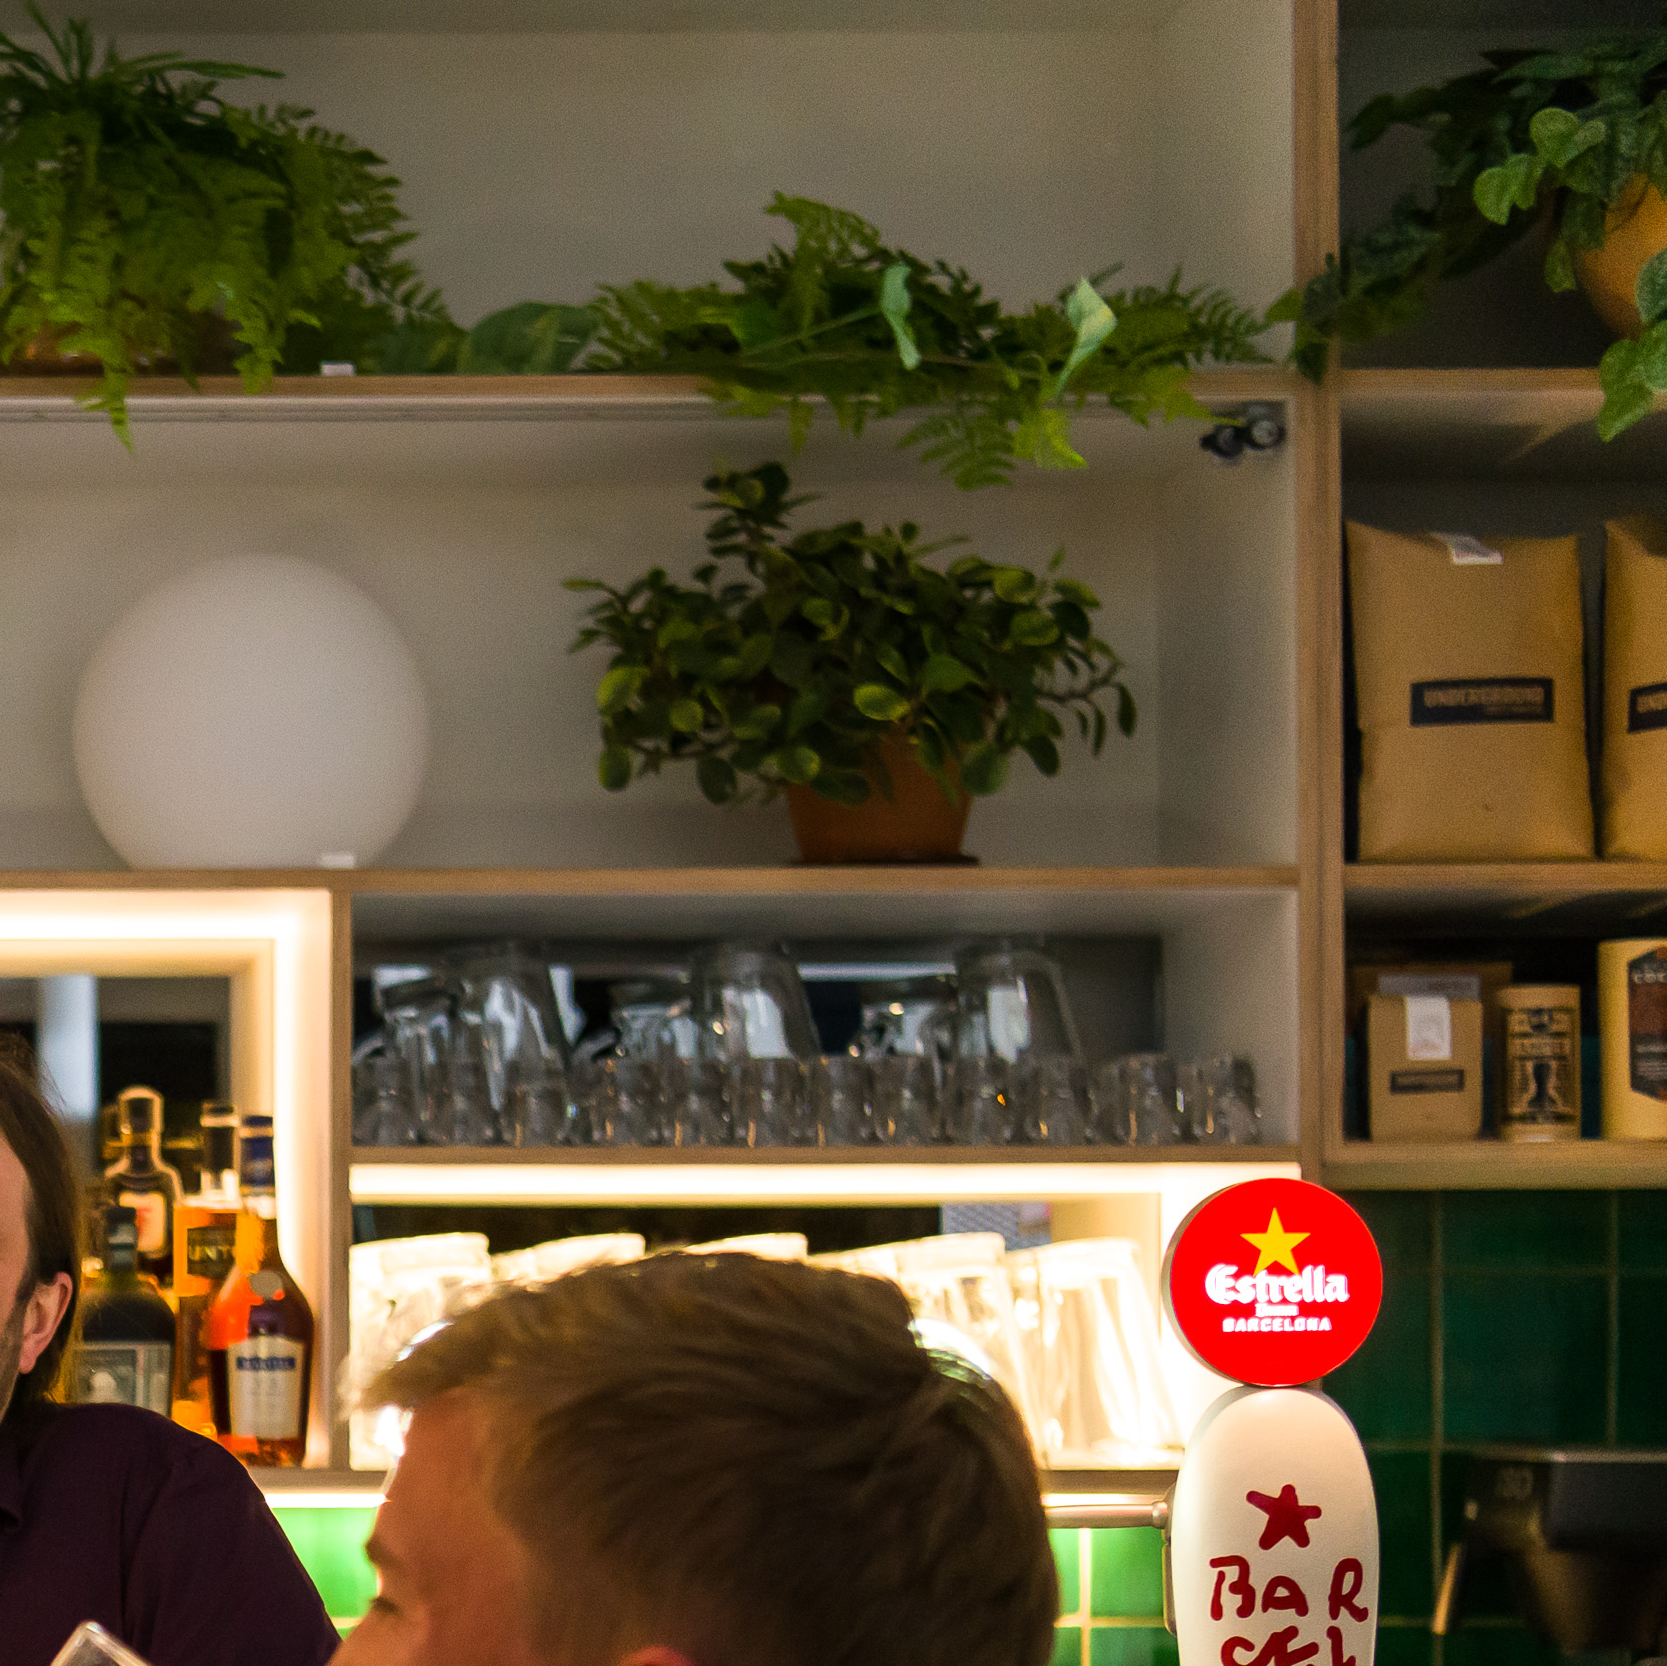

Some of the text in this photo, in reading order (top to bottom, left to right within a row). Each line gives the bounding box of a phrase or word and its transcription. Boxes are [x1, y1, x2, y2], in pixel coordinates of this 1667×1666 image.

[1205, 1264, 1350, 1304] Estrella
[1222, 1317, 1332, 1332] BARCELONA
[1209, 1555, 1369, 1622] BAR
